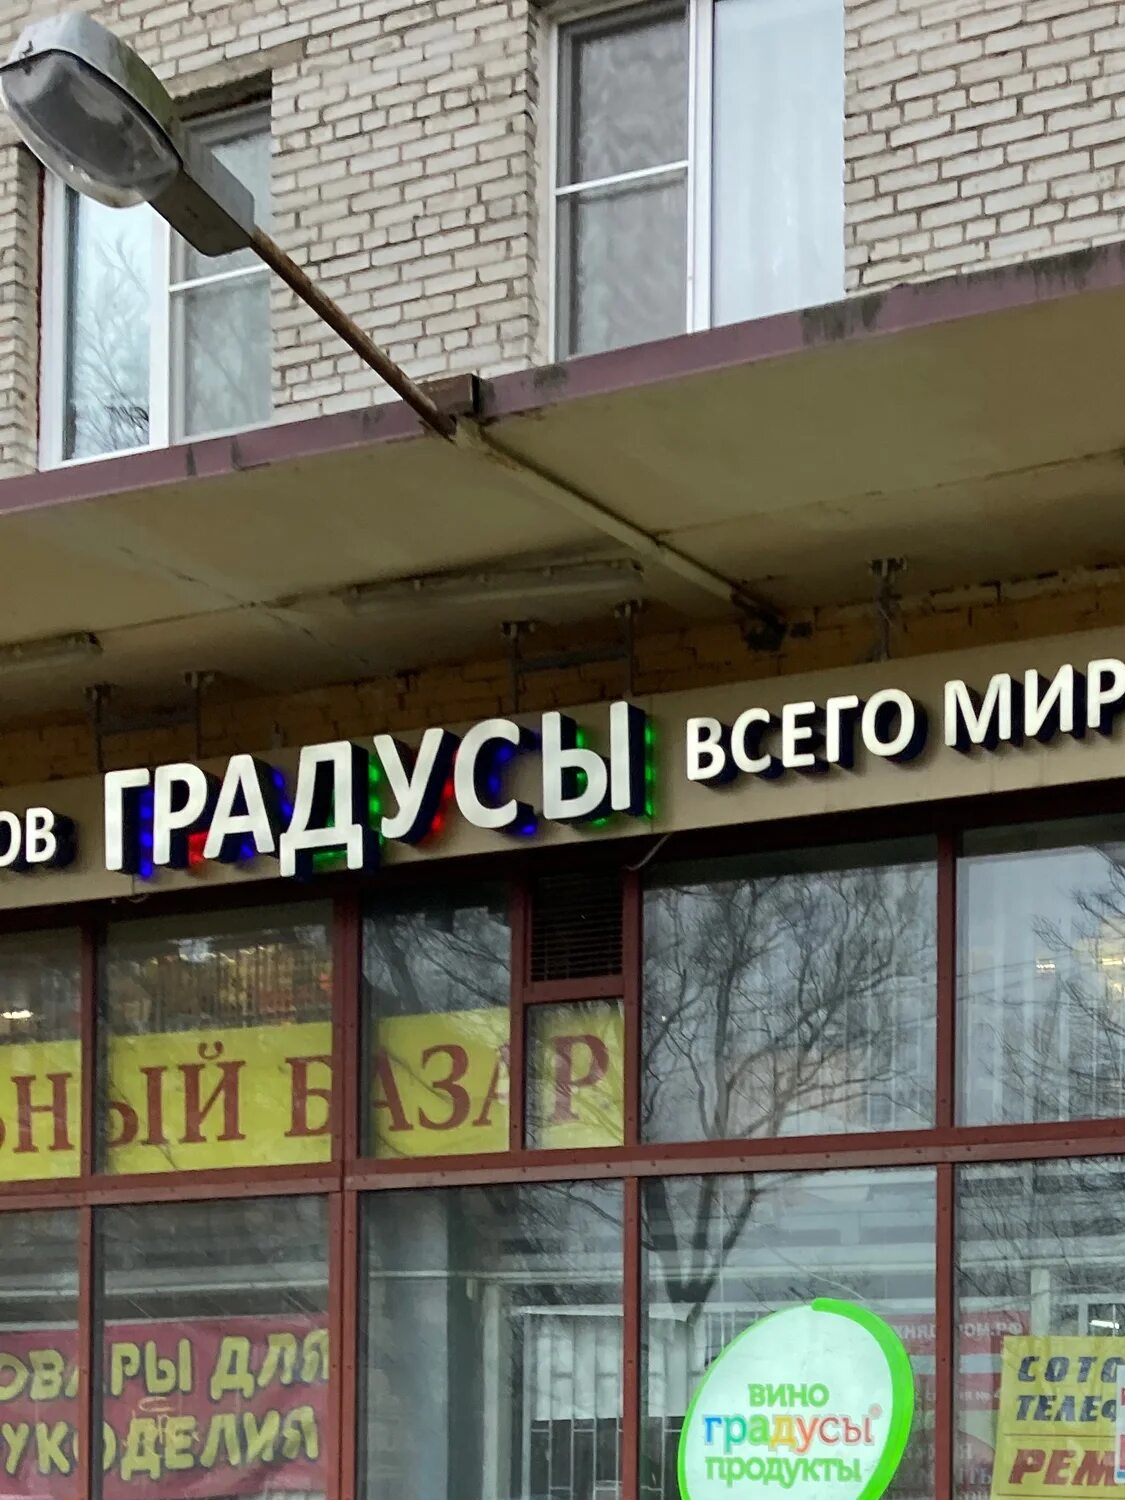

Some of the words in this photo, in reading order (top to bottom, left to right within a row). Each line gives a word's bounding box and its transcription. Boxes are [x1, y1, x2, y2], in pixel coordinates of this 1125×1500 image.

[103, 700, 634, 878] ГРАДУСЫ
[686, 688, 916, 782] ВСЕГО
[210, 1328, 329, 1401] ДЛЯ
[703, 1413, 875, 1455] градусы
[705, 1455, 863, 1489] продукты
